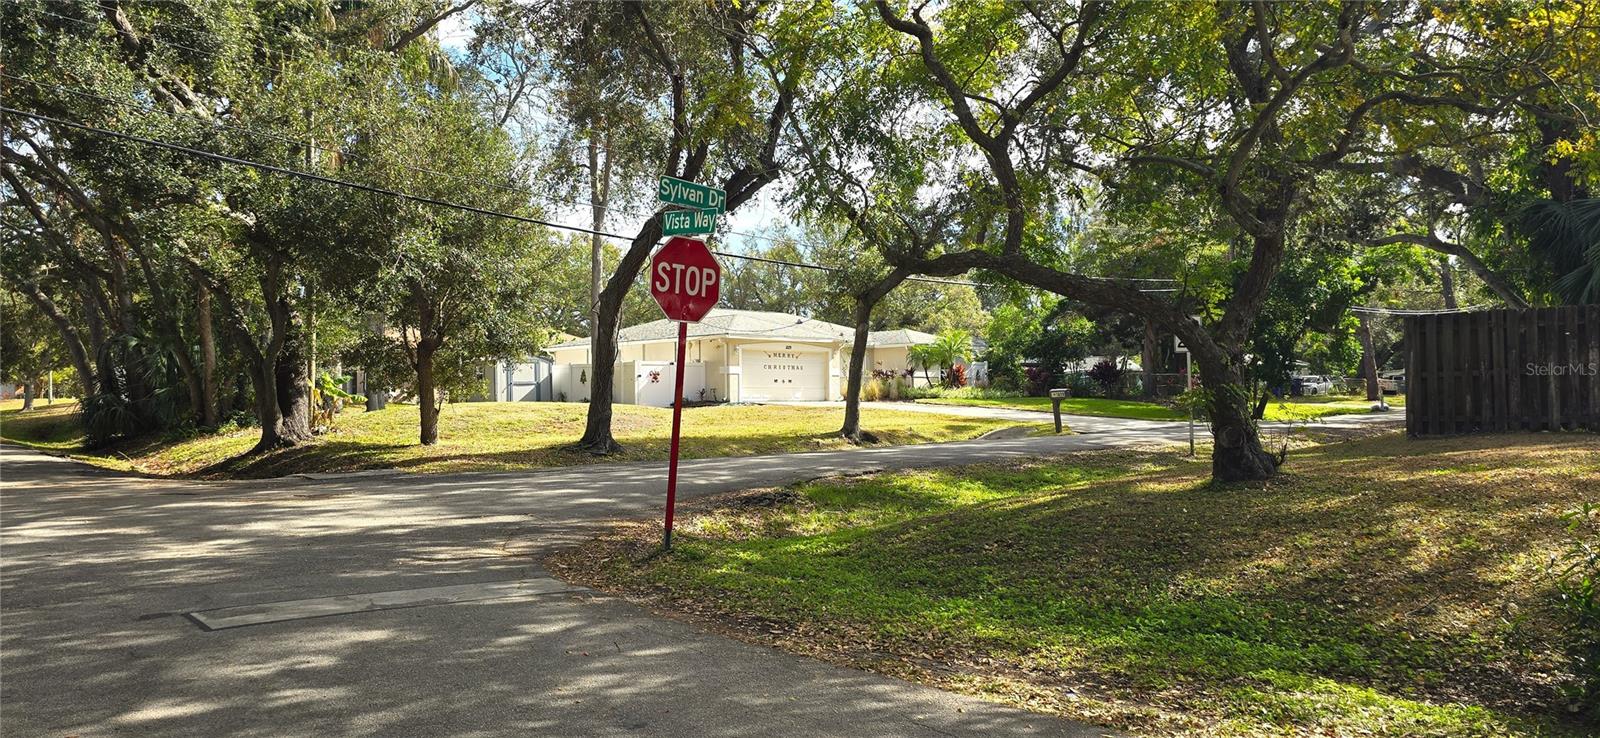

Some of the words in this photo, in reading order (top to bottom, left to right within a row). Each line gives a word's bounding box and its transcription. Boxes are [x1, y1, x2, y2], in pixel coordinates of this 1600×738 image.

[660, 178, 703, 204] Sylvan
[708, 189, 724, 208] Dr
[665, 212, 690, 230] Vista
[694, 211, 715, 231] Way
[655, 261, 716, 298] STOP
